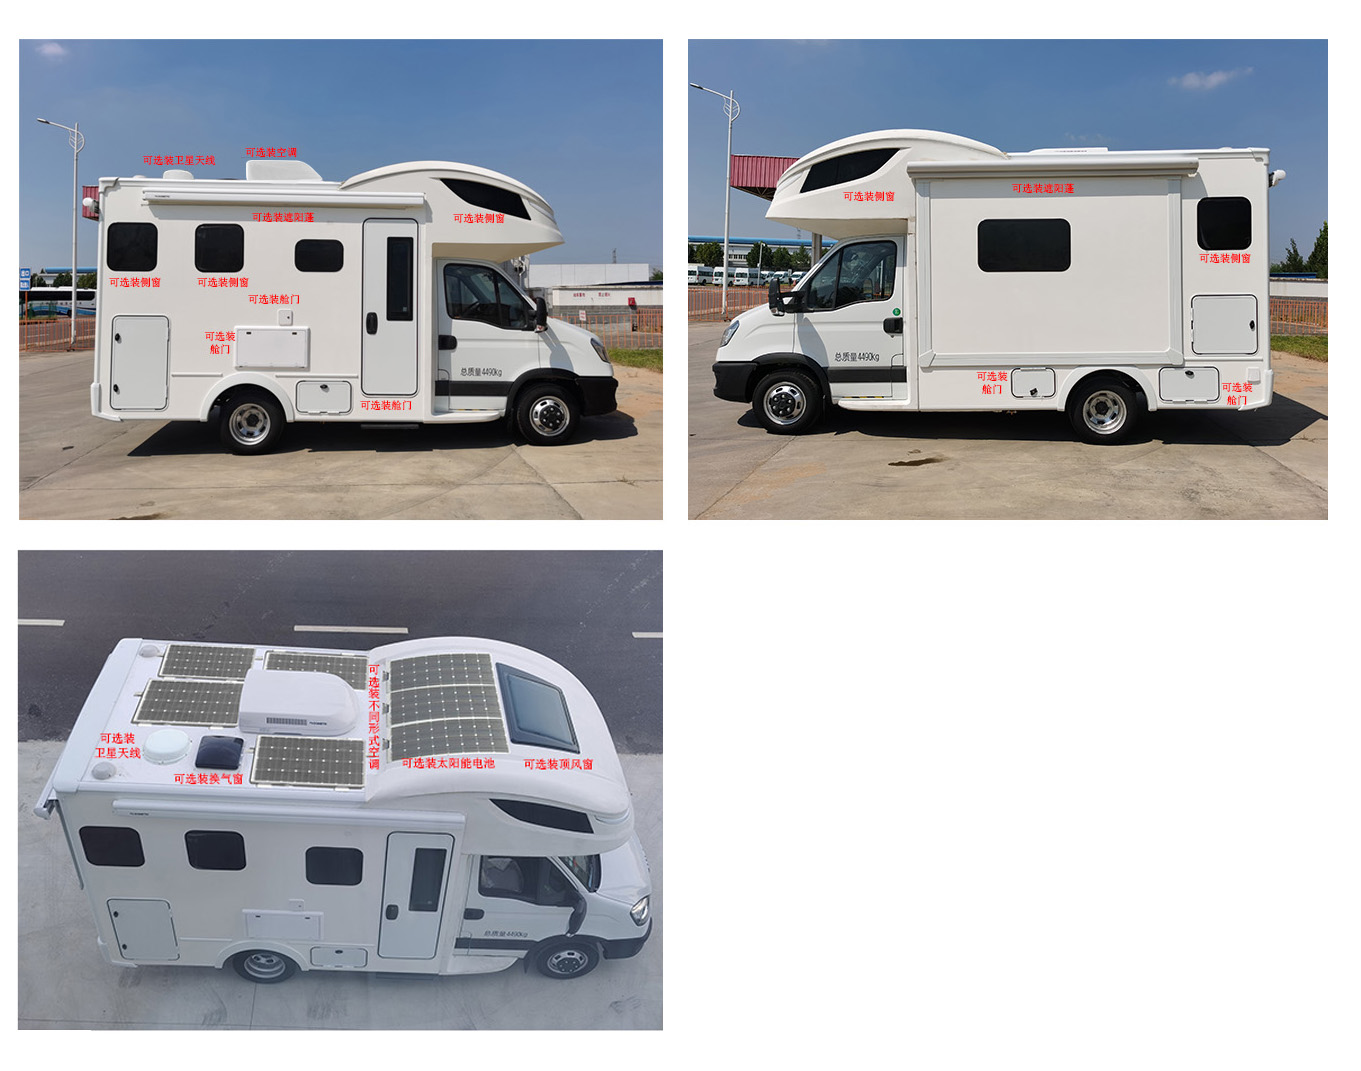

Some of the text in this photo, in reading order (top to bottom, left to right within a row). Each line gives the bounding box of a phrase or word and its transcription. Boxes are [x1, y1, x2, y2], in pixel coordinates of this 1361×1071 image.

[835, 352, 880, 362] 总质量4490kg
[460, 367, 503, 377] 总质量4490kg
